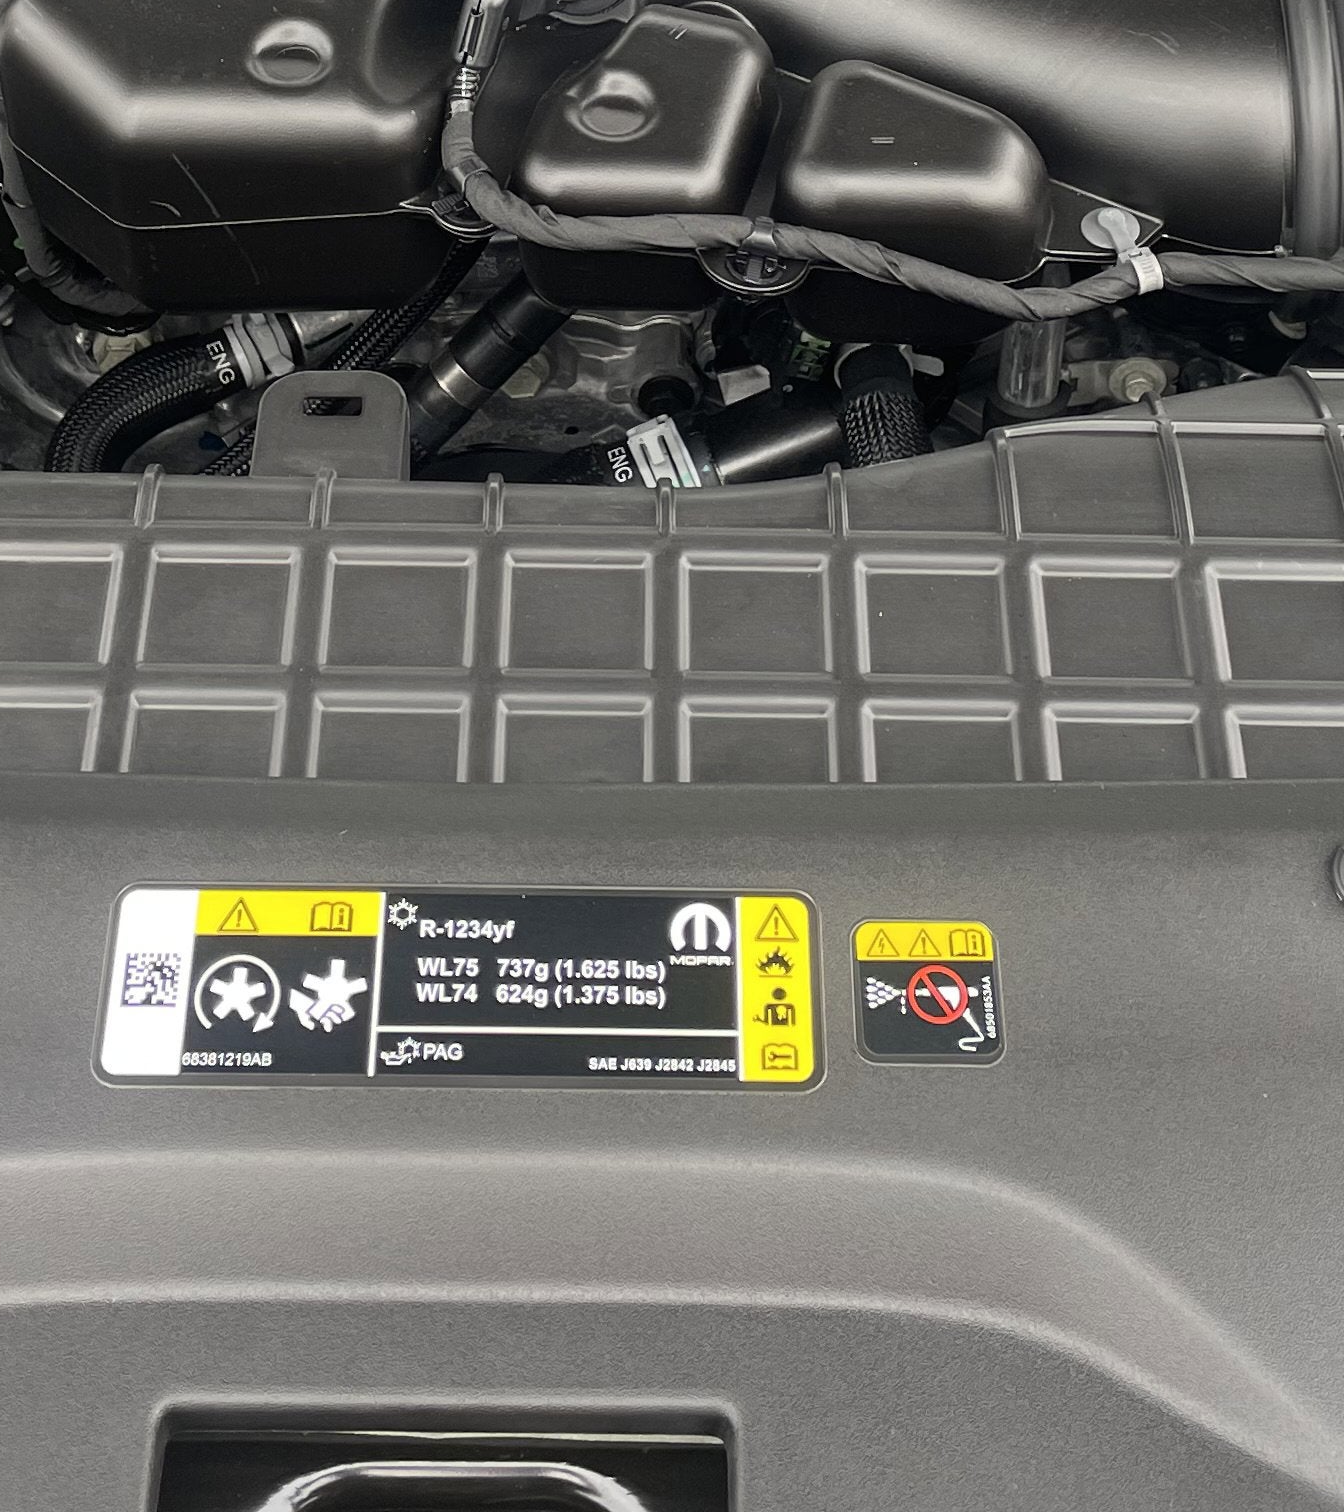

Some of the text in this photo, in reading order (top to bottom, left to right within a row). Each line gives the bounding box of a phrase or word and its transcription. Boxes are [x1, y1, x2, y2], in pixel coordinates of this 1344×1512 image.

[206, 340, 236, 385] ENG
[607, 446, 633, 483] ENG
[419, 919, 516, 944] R-1234yf
[417, 957, 667, 984] WL75 737g (1.625 lbs)
[669, 955, 732, 967] MOPAR
[416, 983, 667, 1010] WL74 624g (1.375 lbs)
[181, 1052, 273, 1067] 68381219AB
[422, 1043, 465, 1063] PAG
[588, 1057, 737, 1072] SAE J639 J2842 J2845
